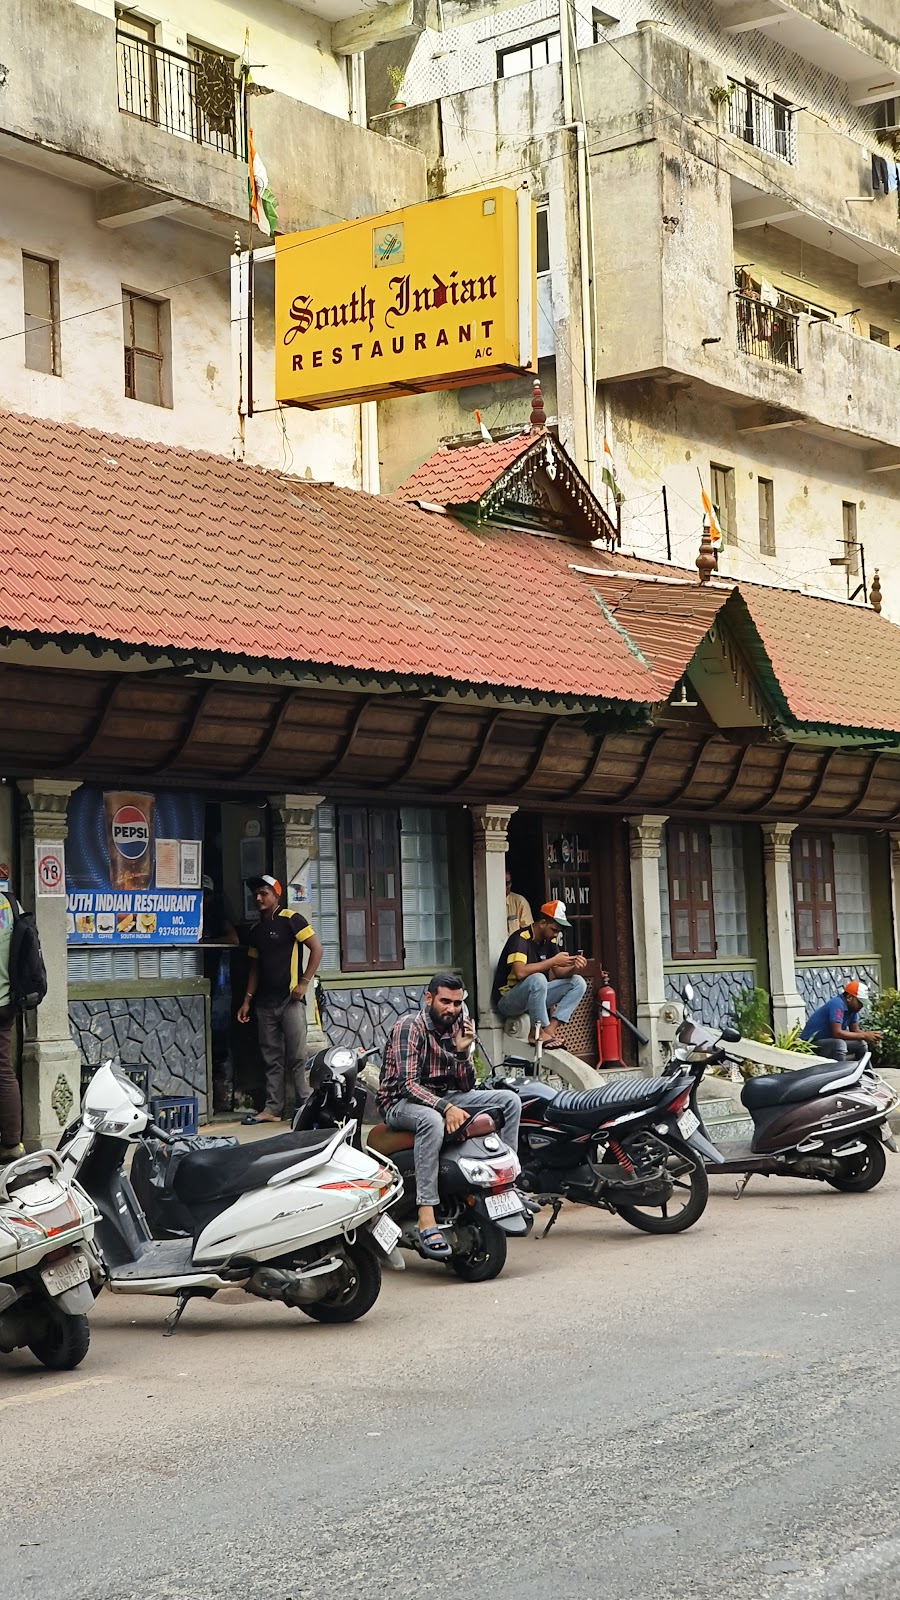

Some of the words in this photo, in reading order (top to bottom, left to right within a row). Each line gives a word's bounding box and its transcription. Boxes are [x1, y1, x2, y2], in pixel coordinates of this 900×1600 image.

[283, 284, 376, 346] South
[385, 270, 497, 329] Indian
[292, 320, 494, 372] RESTAURANT
[474, 347, 493, 359] A/C
[114, 826, 149, 839] PEPSI
[43, 865, 58, 880] 18
[95, 894, 133, 912] INDIAN
[134, 894, 197, 912] RESTAURANT
[172, 916, 185, 925] MO.
[158, 927, 198, 936] 9374810223
